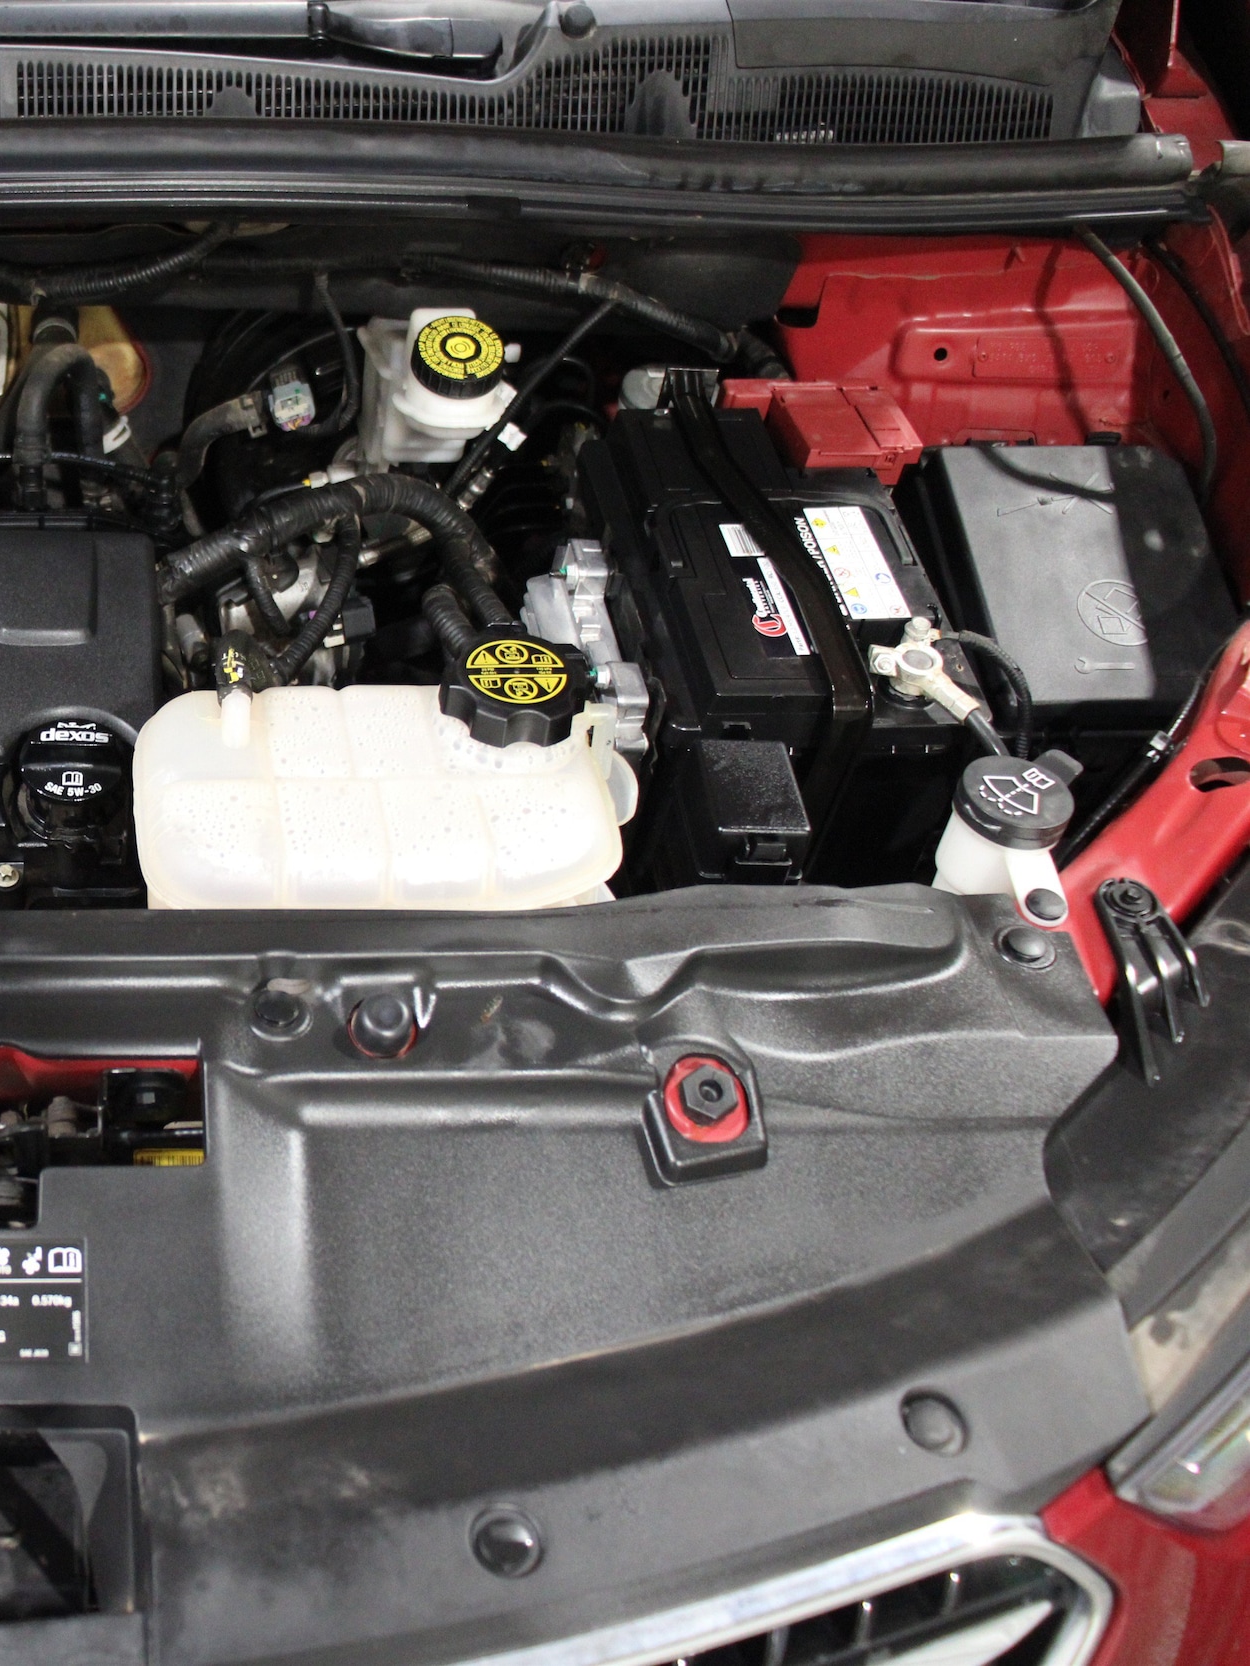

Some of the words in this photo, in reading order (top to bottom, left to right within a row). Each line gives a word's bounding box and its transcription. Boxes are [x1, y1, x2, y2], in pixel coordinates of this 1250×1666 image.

[40, 728, 109, 743] dexos
[44, 782, 65, 796] SAE
[67, 783, 102, 797] 5W-30
